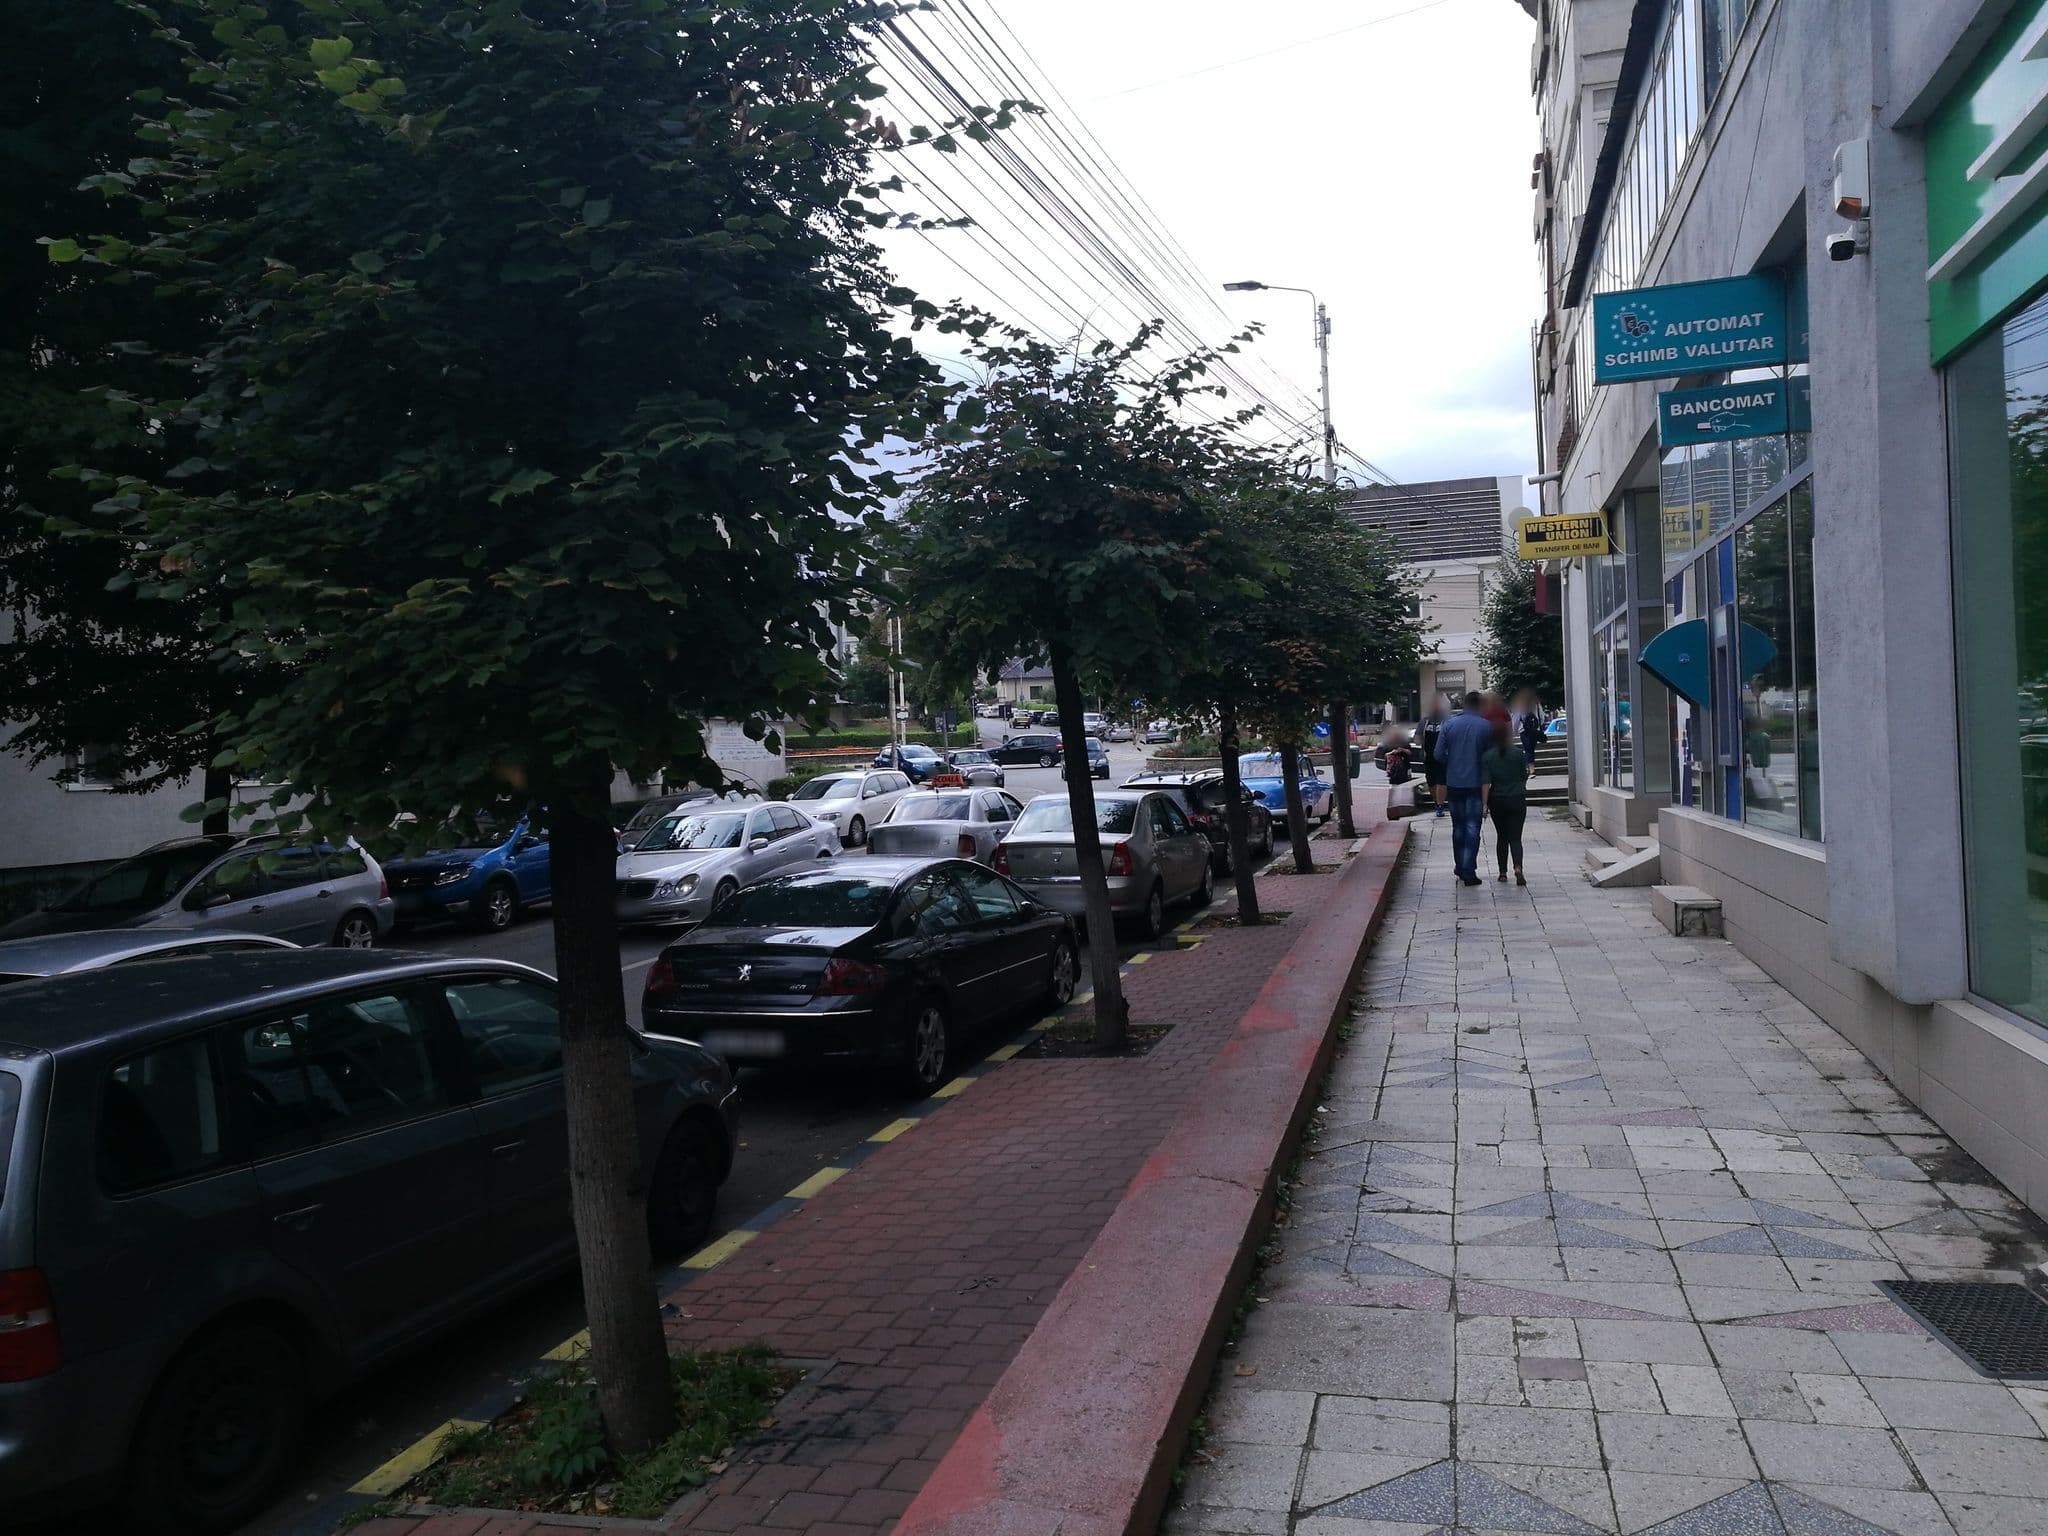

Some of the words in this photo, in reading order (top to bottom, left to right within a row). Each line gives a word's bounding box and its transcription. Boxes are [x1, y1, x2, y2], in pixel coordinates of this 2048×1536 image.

[1664, 312, 1764, 337] AUTOMAT
[1605, 347, 1679, 367] SCHIMB
[1684, 336, 1775, 358] VALUTAR
[1670, 392, 1777, 417] BANCOMAT
[1525, 519, 1589, 533] WESTERN
[1545, 528, 1589, 541] UNION
[1535, 544, 1571, 553] TRANSFER
